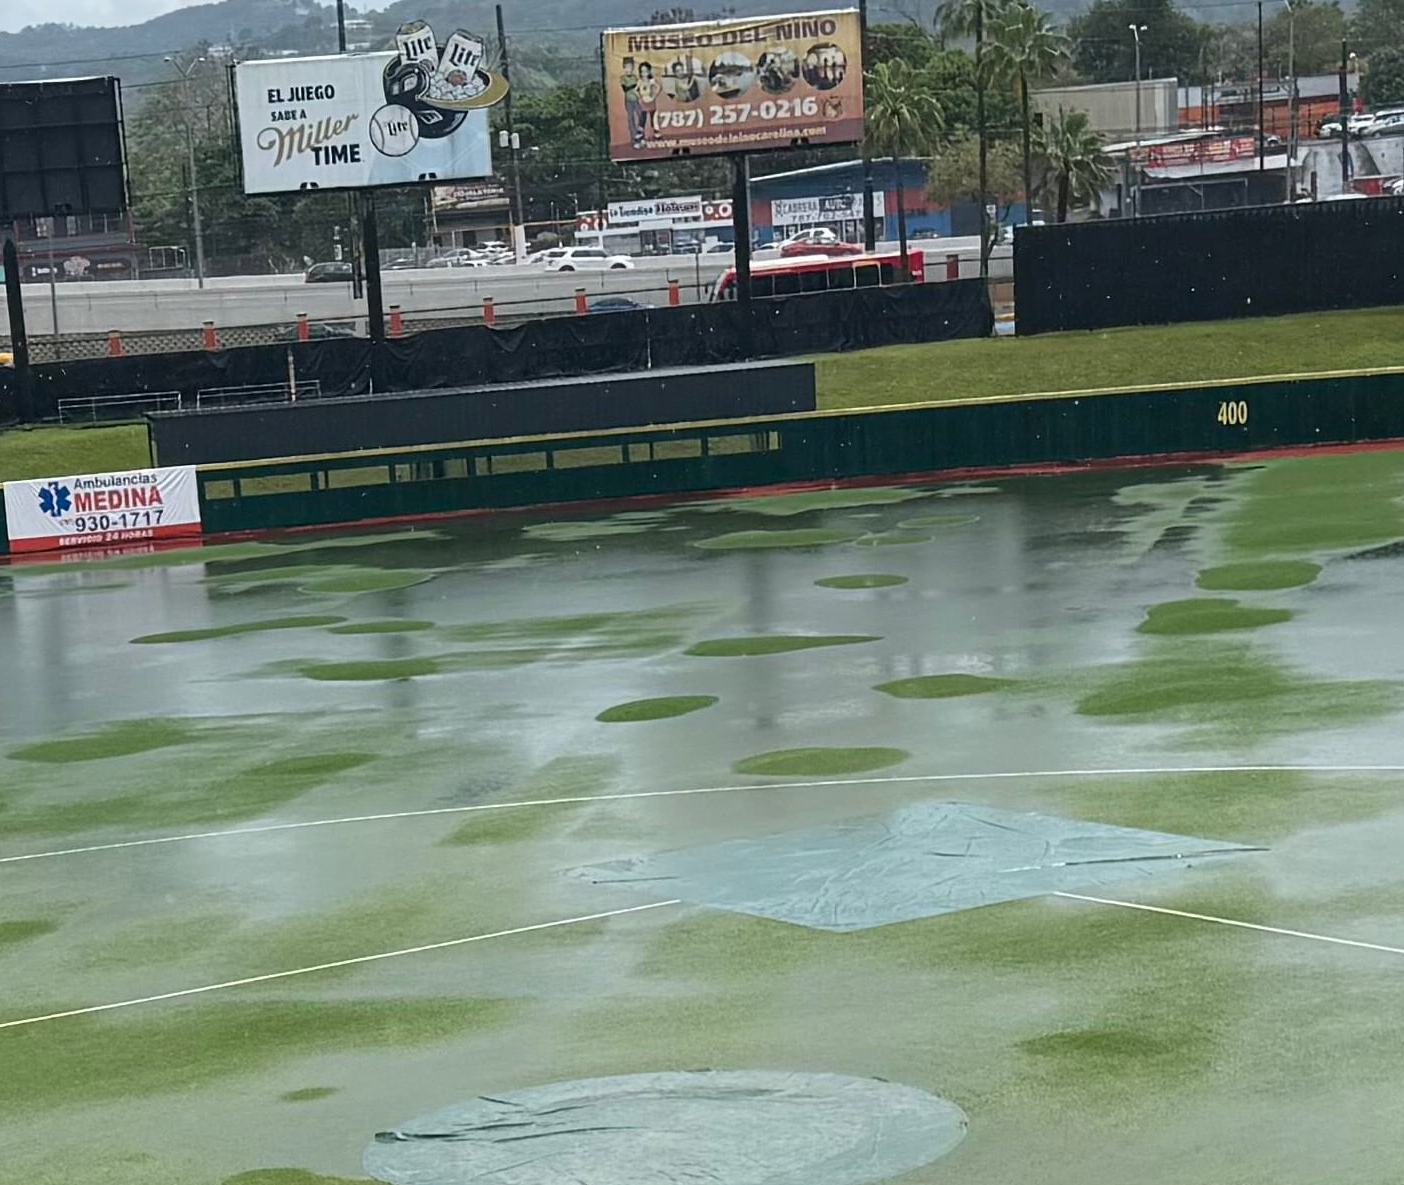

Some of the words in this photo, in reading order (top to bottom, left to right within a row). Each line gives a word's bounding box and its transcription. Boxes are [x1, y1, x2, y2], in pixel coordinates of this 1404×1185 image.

[403, 34, 432, 61] Lite
[628, 32, 713, 53] MUSEO
[722, 25, 767, 45] DEL
[449, 42, 480, 68] Lite
[267, 88, 284, 104] EL
[288, 84, 336, 101] JUEGO
[271, 111, 297, 122] SABE
[300, 110, 307, 120] A
[653, 109, 704, 130] (787)
[709, 96, 819, 124] 257-0216
[257, 112, 360, 168] Miller
[385, 120, 409, 137] Lite
[312, 144, 361, 166] TIME
[1217, 401, 1248, 425] 400
[74, 473, 157, 490] Ambulancias
[75, 486, 163, 513] MEDINA
[75, 509, 164, 532] 930-1717
[59, 535, 103, 546] SERVICIO
[105, 532, 120, 542] 24
[121, 529, 153, 539] HORAS
